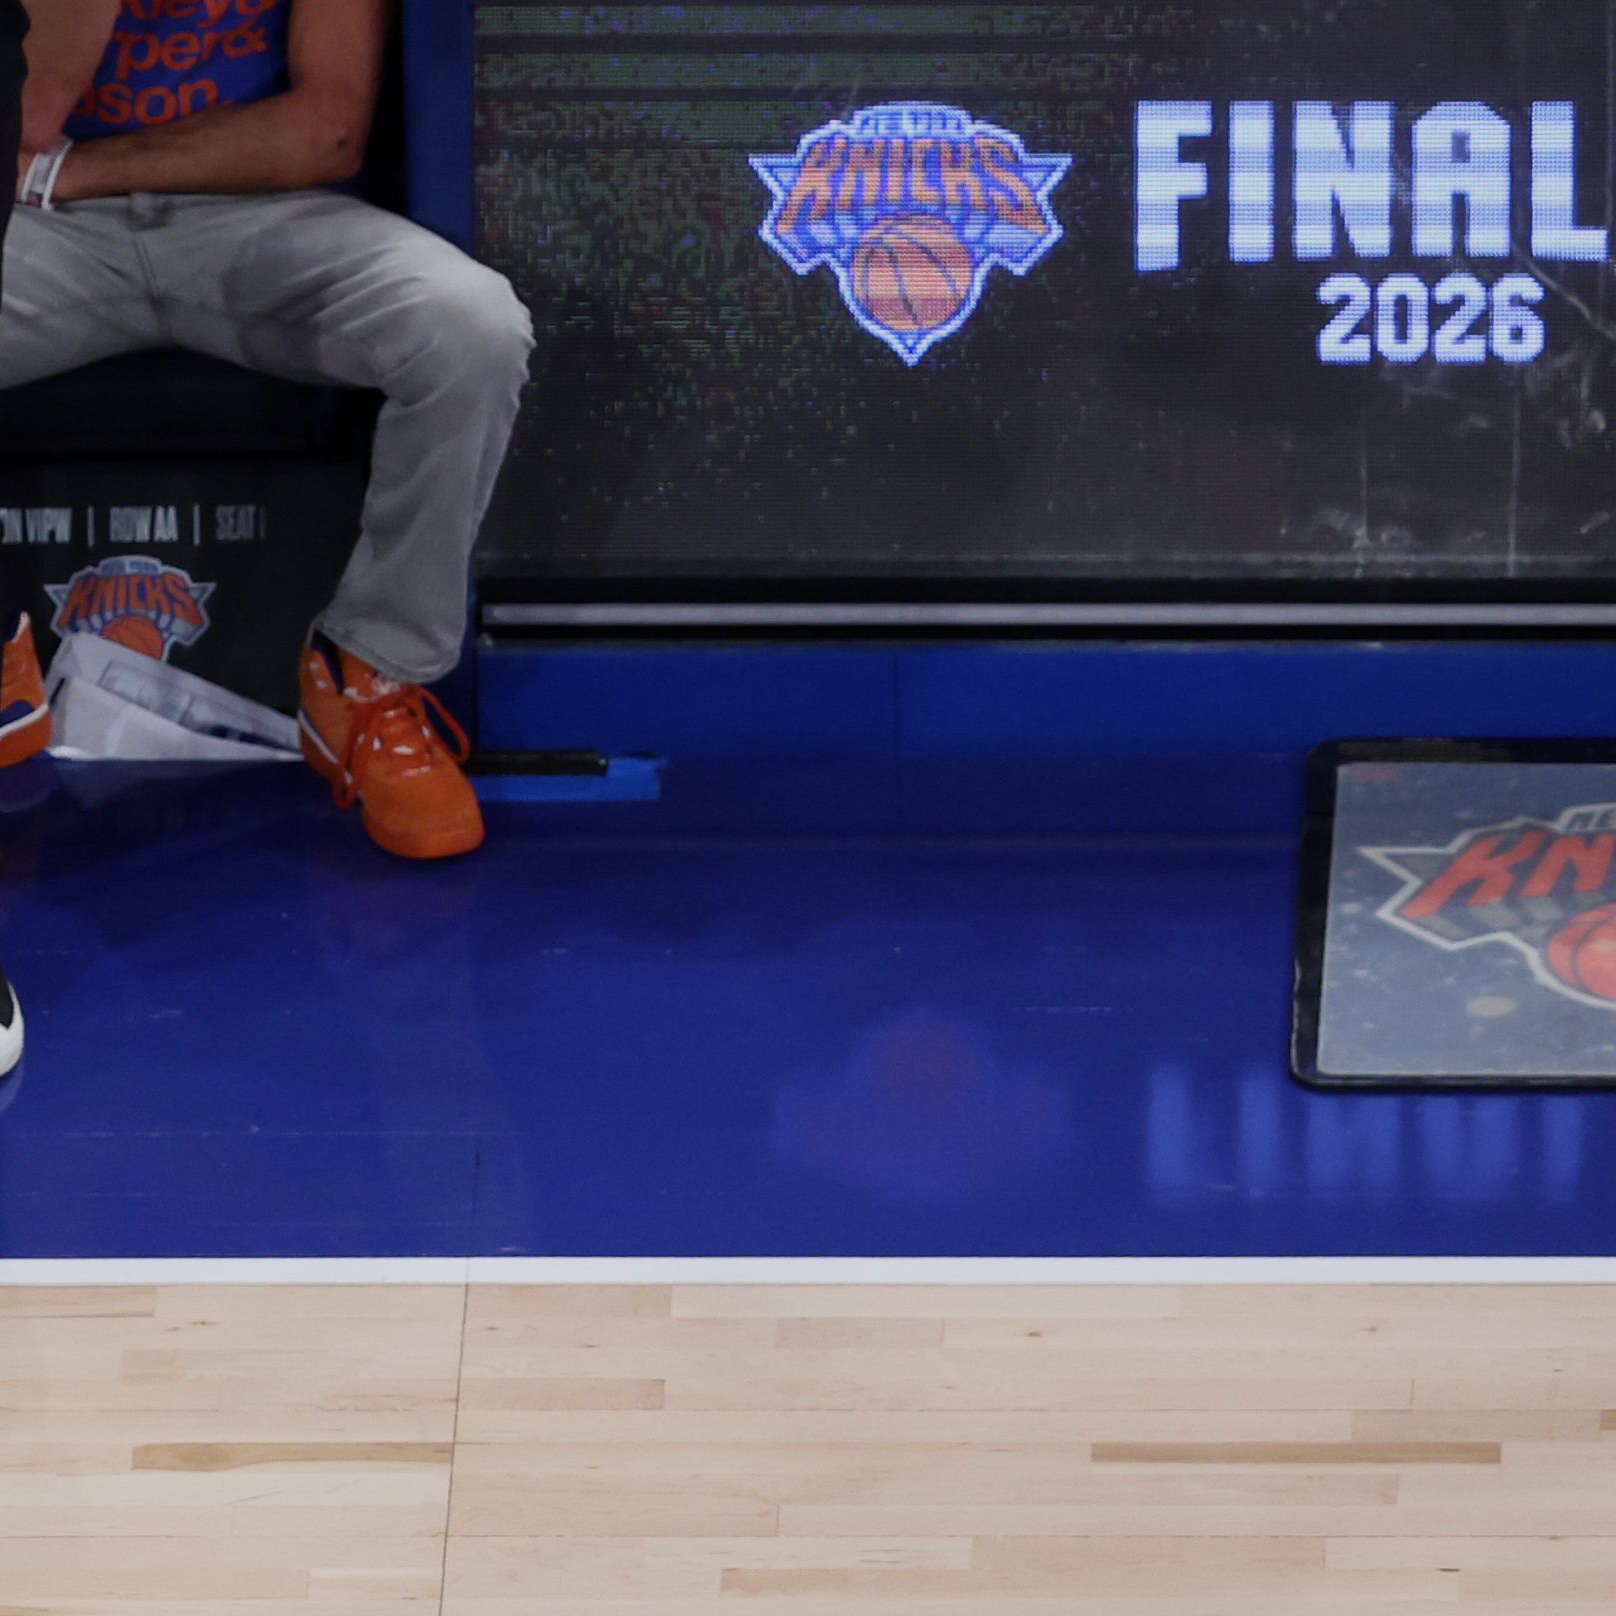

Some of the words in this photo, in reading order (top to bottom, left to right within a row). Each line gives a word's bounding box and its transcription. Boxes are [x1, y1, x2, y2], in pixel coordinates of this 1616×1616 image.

[775, 135, 1049, 235] KNICKS
[1135, 100, 1609, 272] FINAL
[1316, 273, 1546, 365] 2026
[215, 504, 256, 542] SEAT
[57, 571, 205, 629] KNICKS
